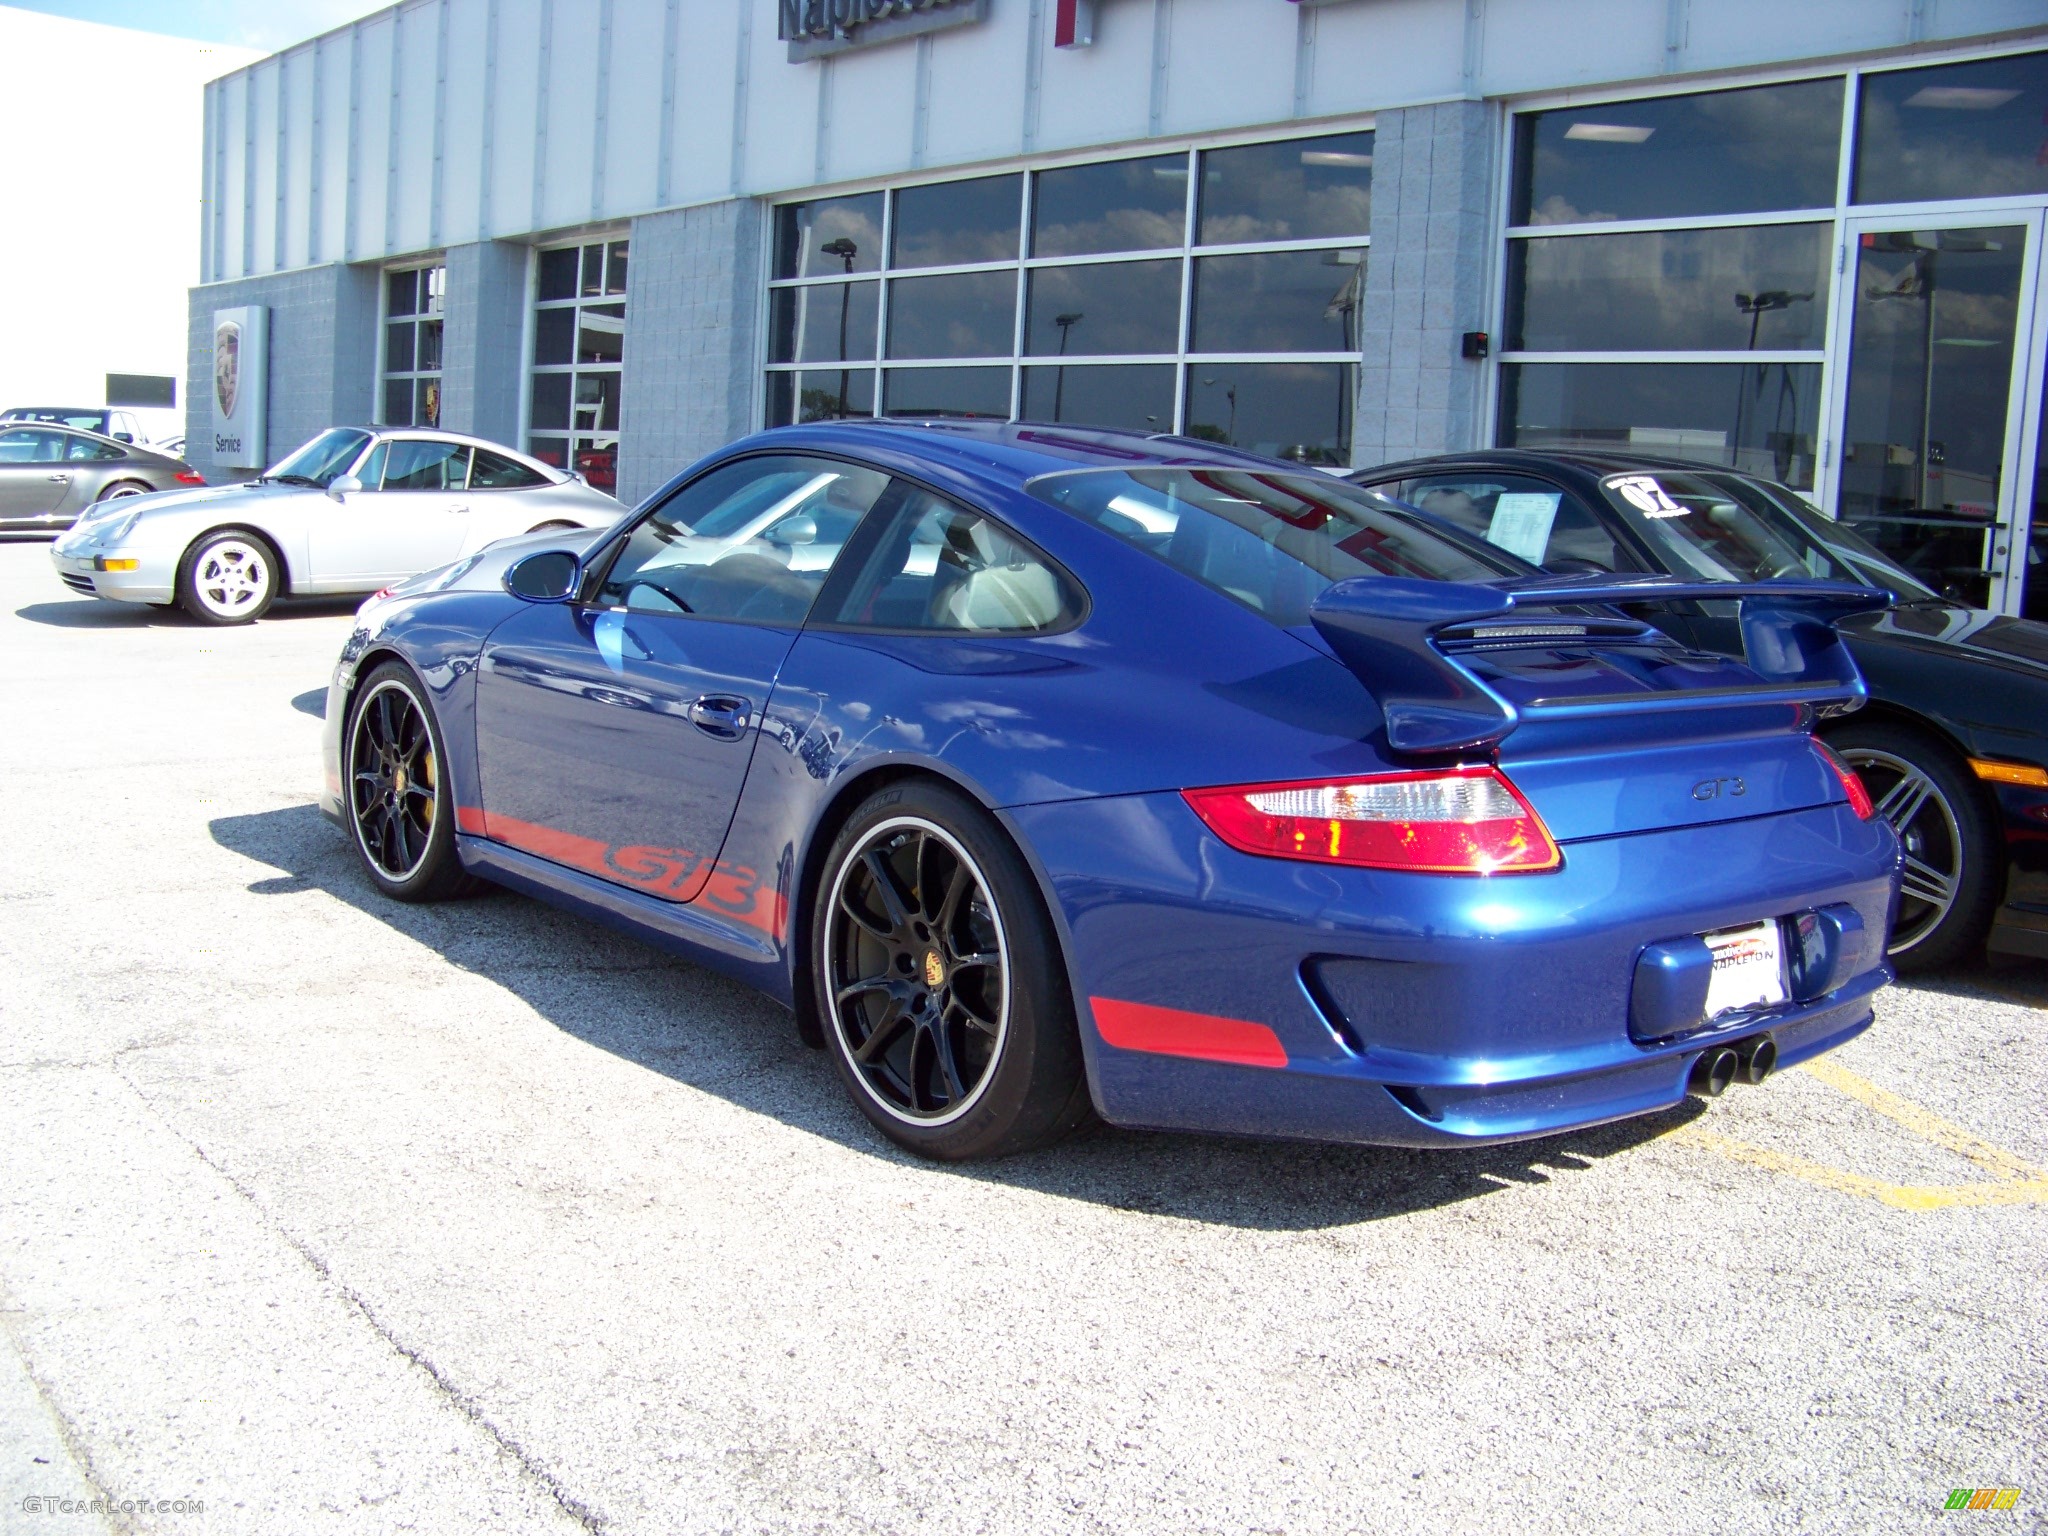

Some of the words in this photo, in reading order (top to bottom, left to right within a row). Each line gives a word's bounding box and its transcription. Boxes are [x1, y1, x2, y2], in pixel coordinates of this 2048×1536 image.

[215, 434, 241, 453] Service
[1620, 479, 1679, 512] 07
[1691, 776, 1745, 801] GT3
[603, 844, 760, 914] GT3
[1713, 950, 1774, 971] NAPLETON
